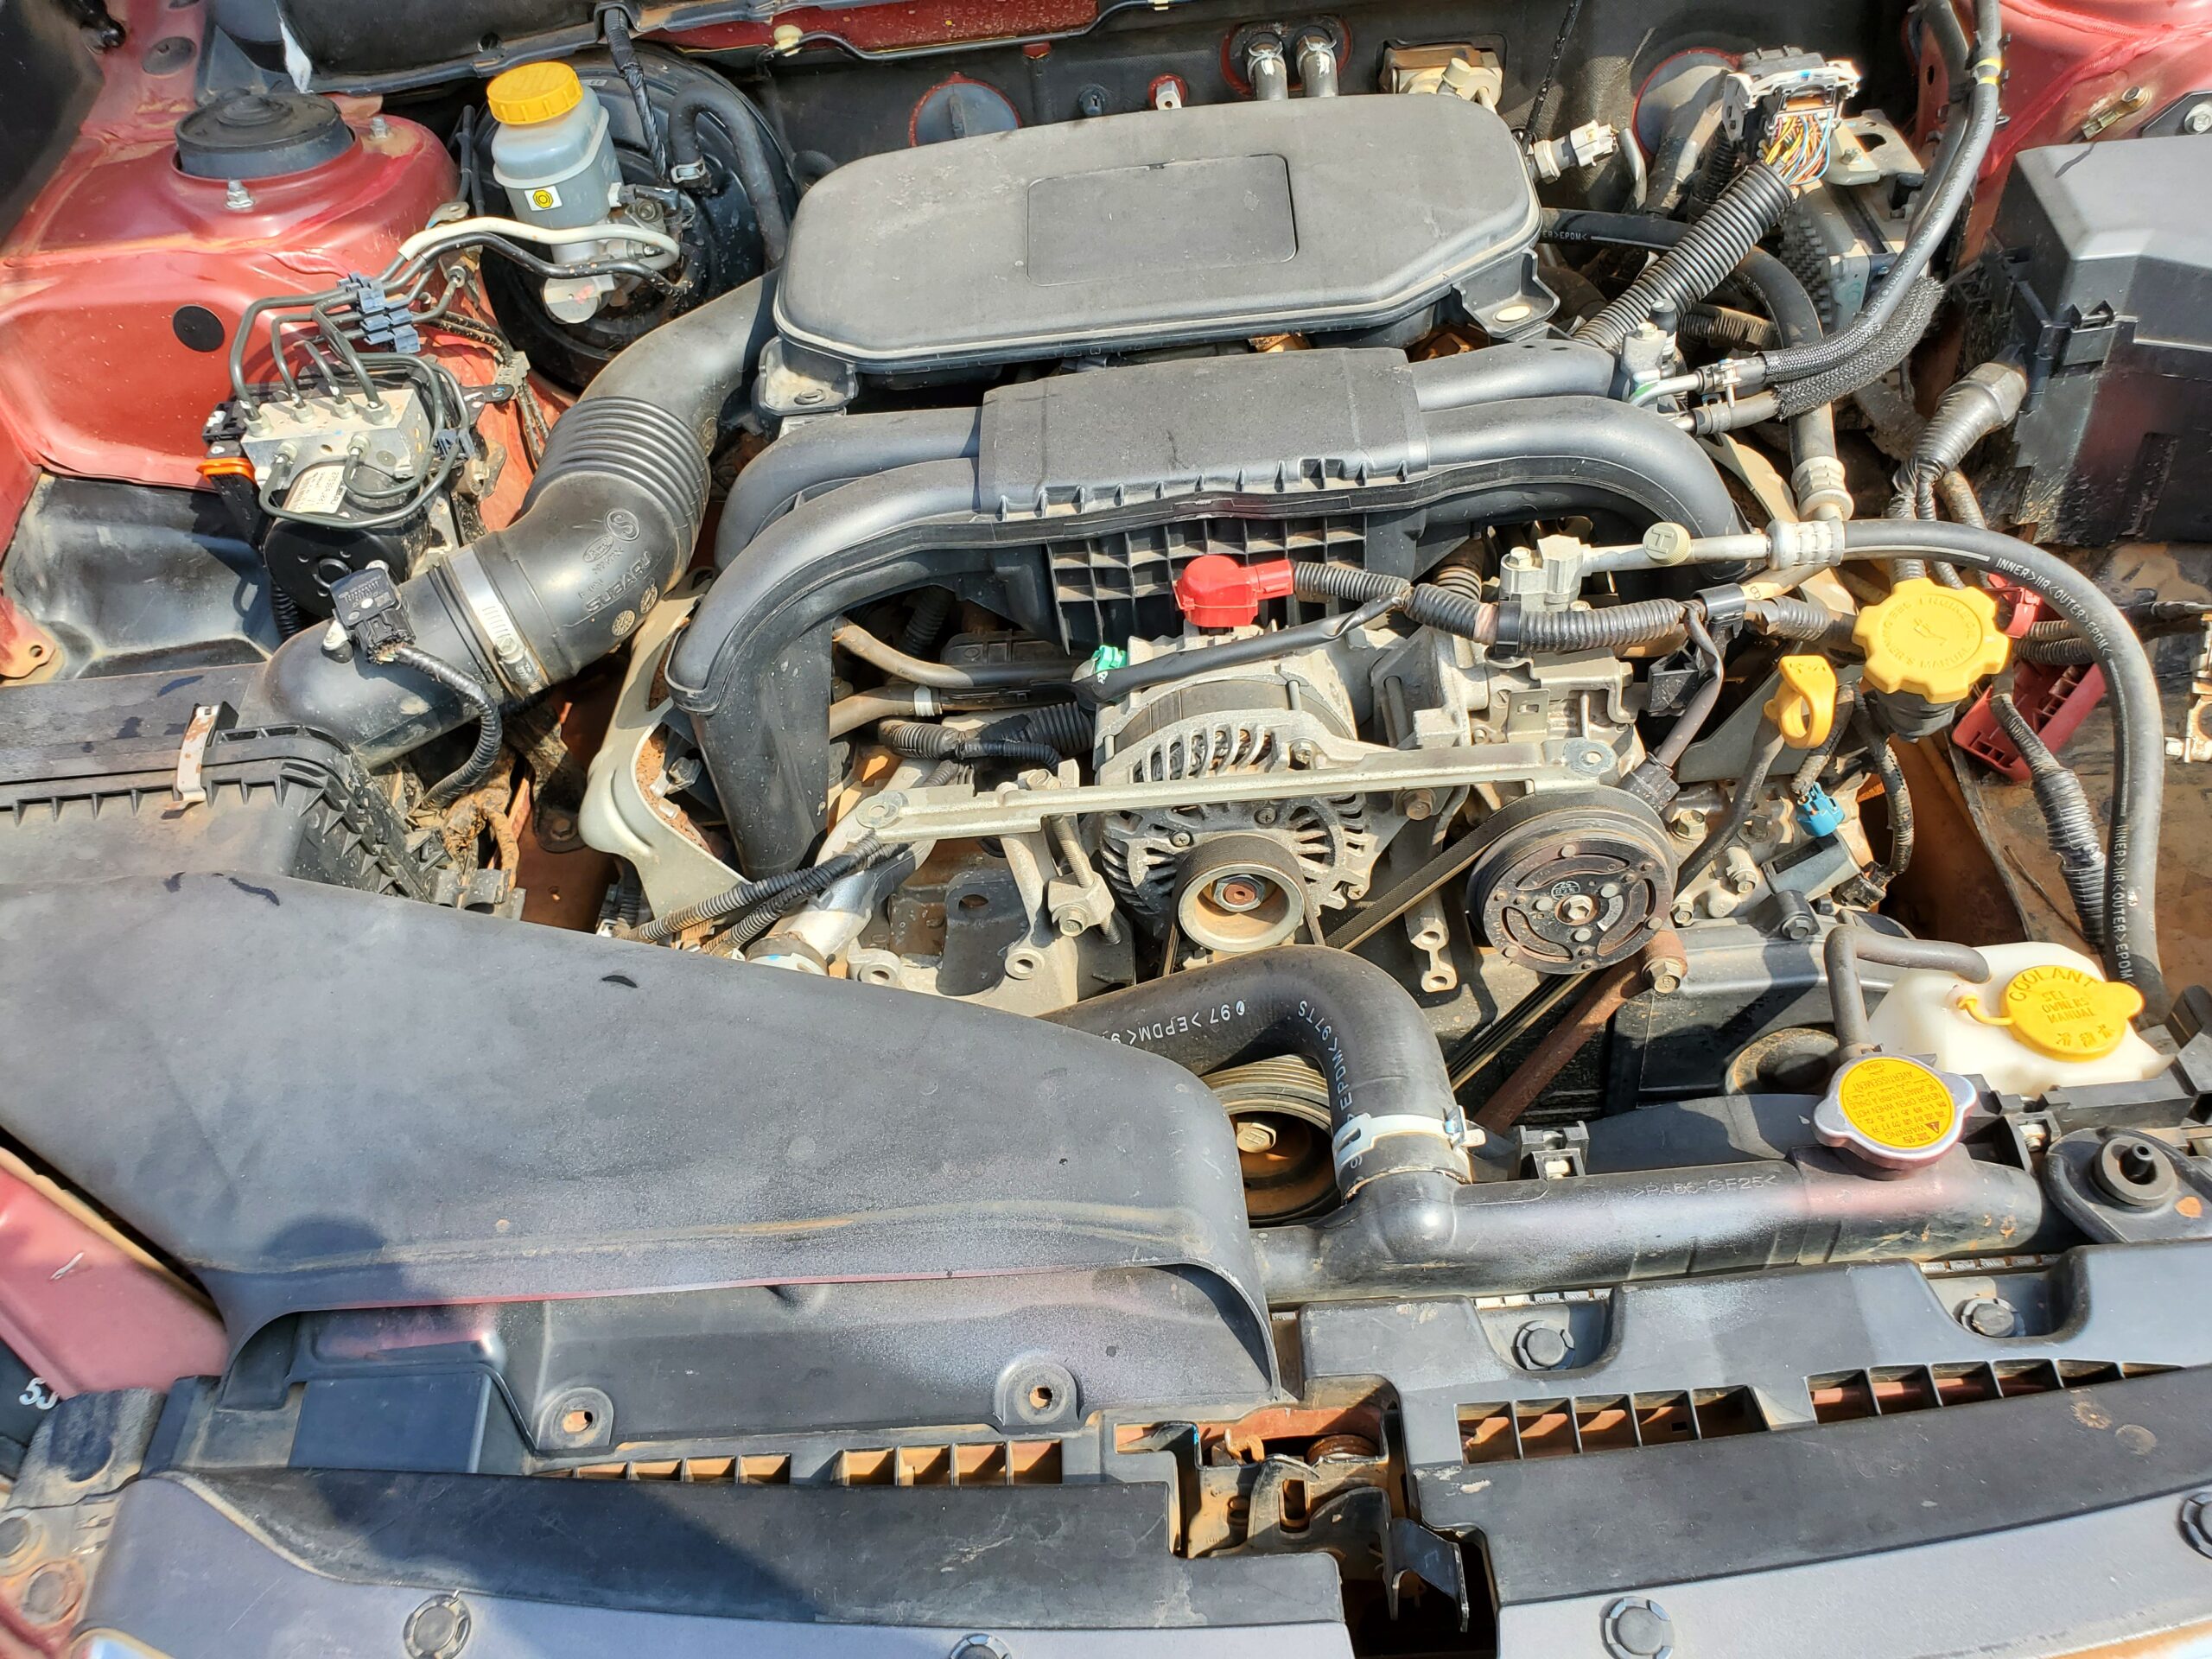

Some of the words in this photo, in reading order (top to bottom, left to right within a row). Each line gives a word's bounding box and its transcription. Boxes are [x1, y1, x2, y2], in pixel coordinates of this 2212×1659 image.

[586, 550, 652, 613] SUBARU
[2009, 967, 2099, 1001] COOLANT
[1853, 1071, 1913, 1090] AVERTISSEMENT
[1898, 1097, 1917, 1108] OPEN
[1918, 1091, 1944, 1103] NEVER
[1872, 1102, 1897, 1115] WHEN
[1885, 1125, 1927, 1140] WARNING
